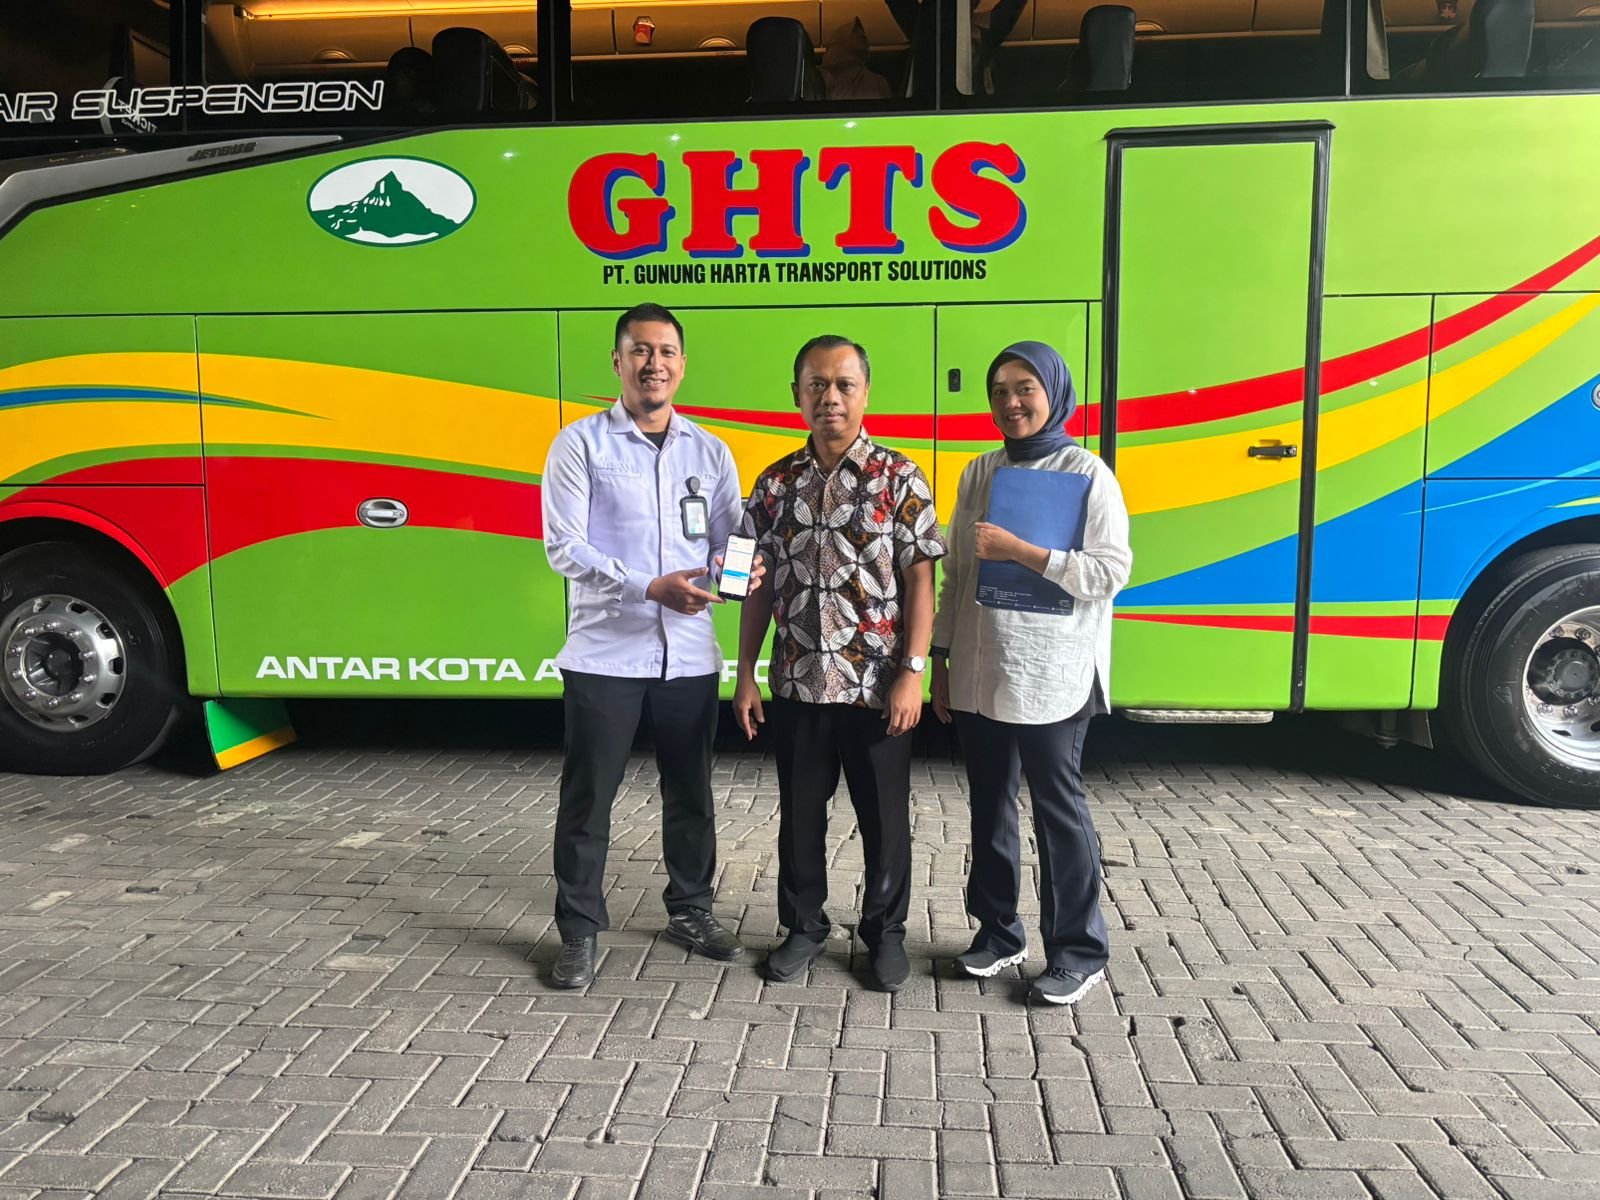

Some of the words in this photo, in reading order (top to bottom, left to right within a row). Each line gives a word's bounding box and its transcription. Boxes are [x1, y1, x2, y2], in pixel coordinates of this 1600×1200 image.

[71, 80, 384, 120] SUSPENSION
[568, 141, 1027, 260] GHTS
[603, 265, 629, 284] PT.
[634, 264, 705, 284] GUNUNG
[710, 263, 770, 283] HARTA
[776, 261, 883, 282] TRANSPORT
[887, 259, 987, 281] SOLUTIONS
[256, 656, 400, 680] ANTAR
[408, 658, 526, 681] KOTA
